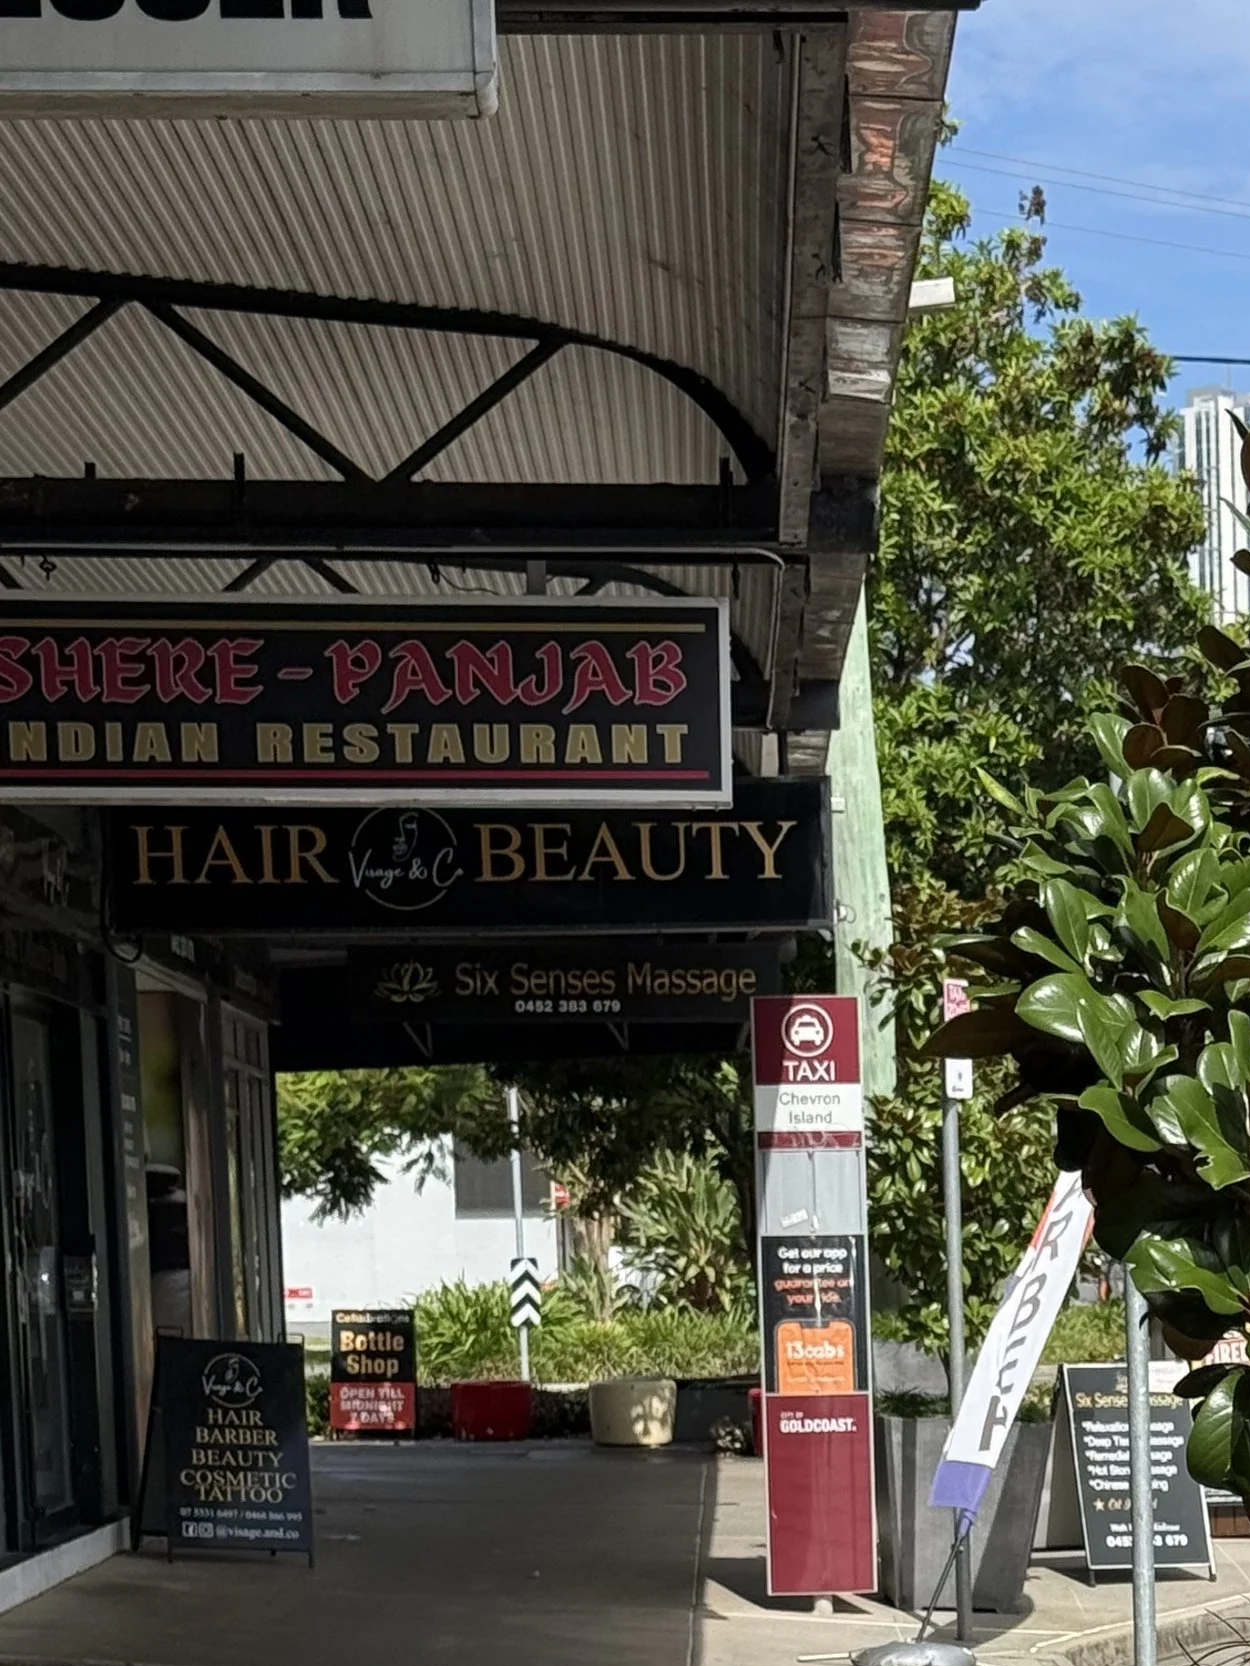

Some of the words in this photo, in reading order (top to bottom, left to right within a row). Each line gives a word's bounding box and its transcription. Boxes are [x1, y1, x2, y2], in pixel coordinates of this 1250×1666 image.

[8, 720, 219, 763] NDIAN
[256, 722, 689, 765] RESTAURANT
[129, 824, 339, 886] HAIR
[473, 820, 799, 883] BEAUTY
[454, 961, 501, 997] Six
[509, 961, 616, 997] Senses
[627, 962, 758, 1003] Massage
[514, 999, 554, 1014] 0452
[558, 999, 587, 1014] 383
[783, 1059, 836, 1082] TAXI
[779, 1091, 841, 1106] Chevron
[789, 1110, 833, 1125] Island
[778, 1247, 800, 1260] Get
[801, 1248, 822, 1260] our
[823, 1248, 848, 1261] app
[783, 1262, 802, 1274] for
[803, 1264, 812, 1274] a
[813, 1262, 844, 1275] price
[786, 1294, 814, 1306] your
[340, 1330, 405, 1352] Bottle
[786, 1340, 845, 1360] 13cabs
[346, 1353, 400, 1379] Shop
[340, 1386, 375, 1400] OPEN
[378, 1387, 405, 1400] TILL
[1075, 1392, 1092, 1408] Six
[1094, 1392, 1128, 1408] Sense
[206, 1407, 264, 1427] HAIR
[360, 1411, 396, 1424] DAYS
[195, 1426, 279, 1447] BARBER
[191, 1448, 285, 1468] BEAUTY
[180, 1468, 297, 1490] COSMETIC
[194, 1483, 284, 1504] TATTOO
